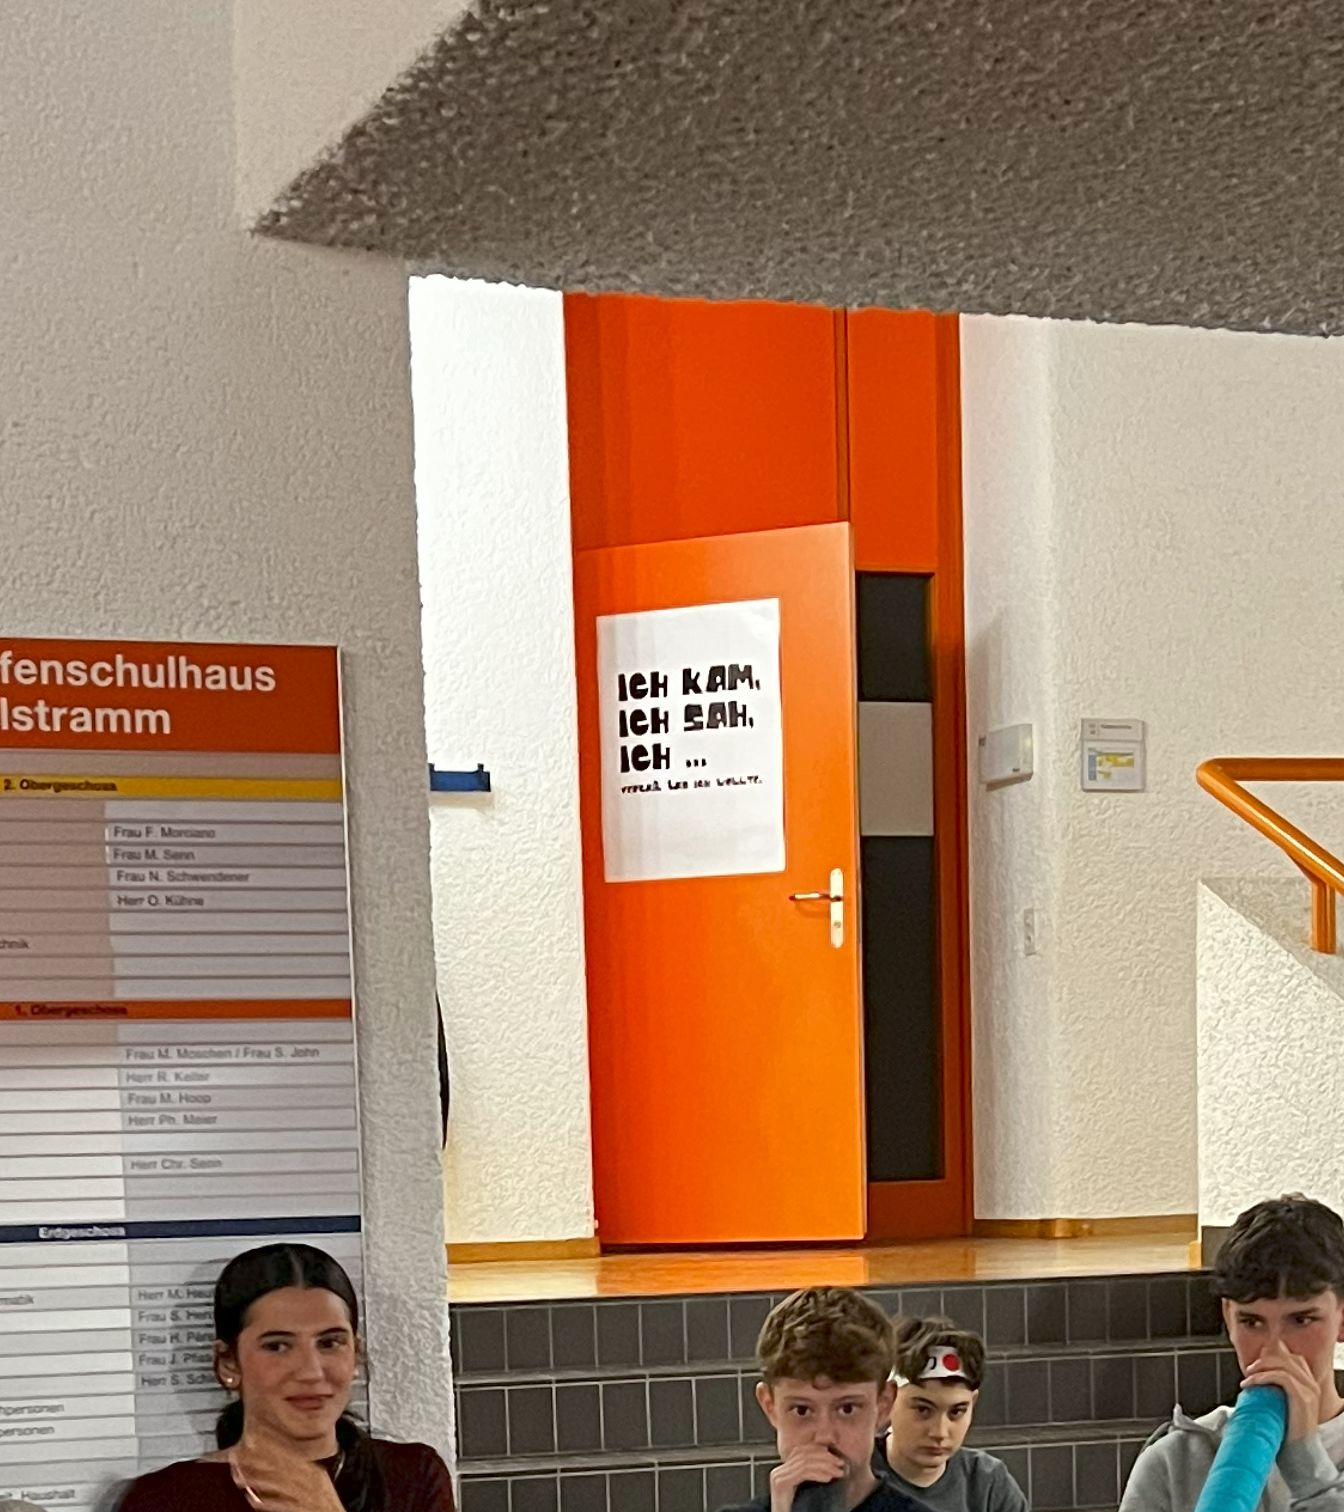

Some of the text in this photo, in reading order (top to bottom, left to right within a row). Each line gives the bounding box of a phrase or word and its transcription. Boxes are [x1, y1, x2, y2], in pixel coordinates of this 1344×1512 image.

[617, 664, 761, 702] ICH KAM,
[618, 700, 754, 738] ICH SAH,
[620, 742, 671, 773] ICH
[113, 827, 141, 838] Frau
[113, 849, 196, 861] Frau M. Senn
[116, 870, 145, 882] Frau
[117, 895, 144, 906] Herr
[126, 1049, 154, 1060] Frau
[243, 1047, 271, 1058] Frau
[128, 1093, 155, 1104] Frau
